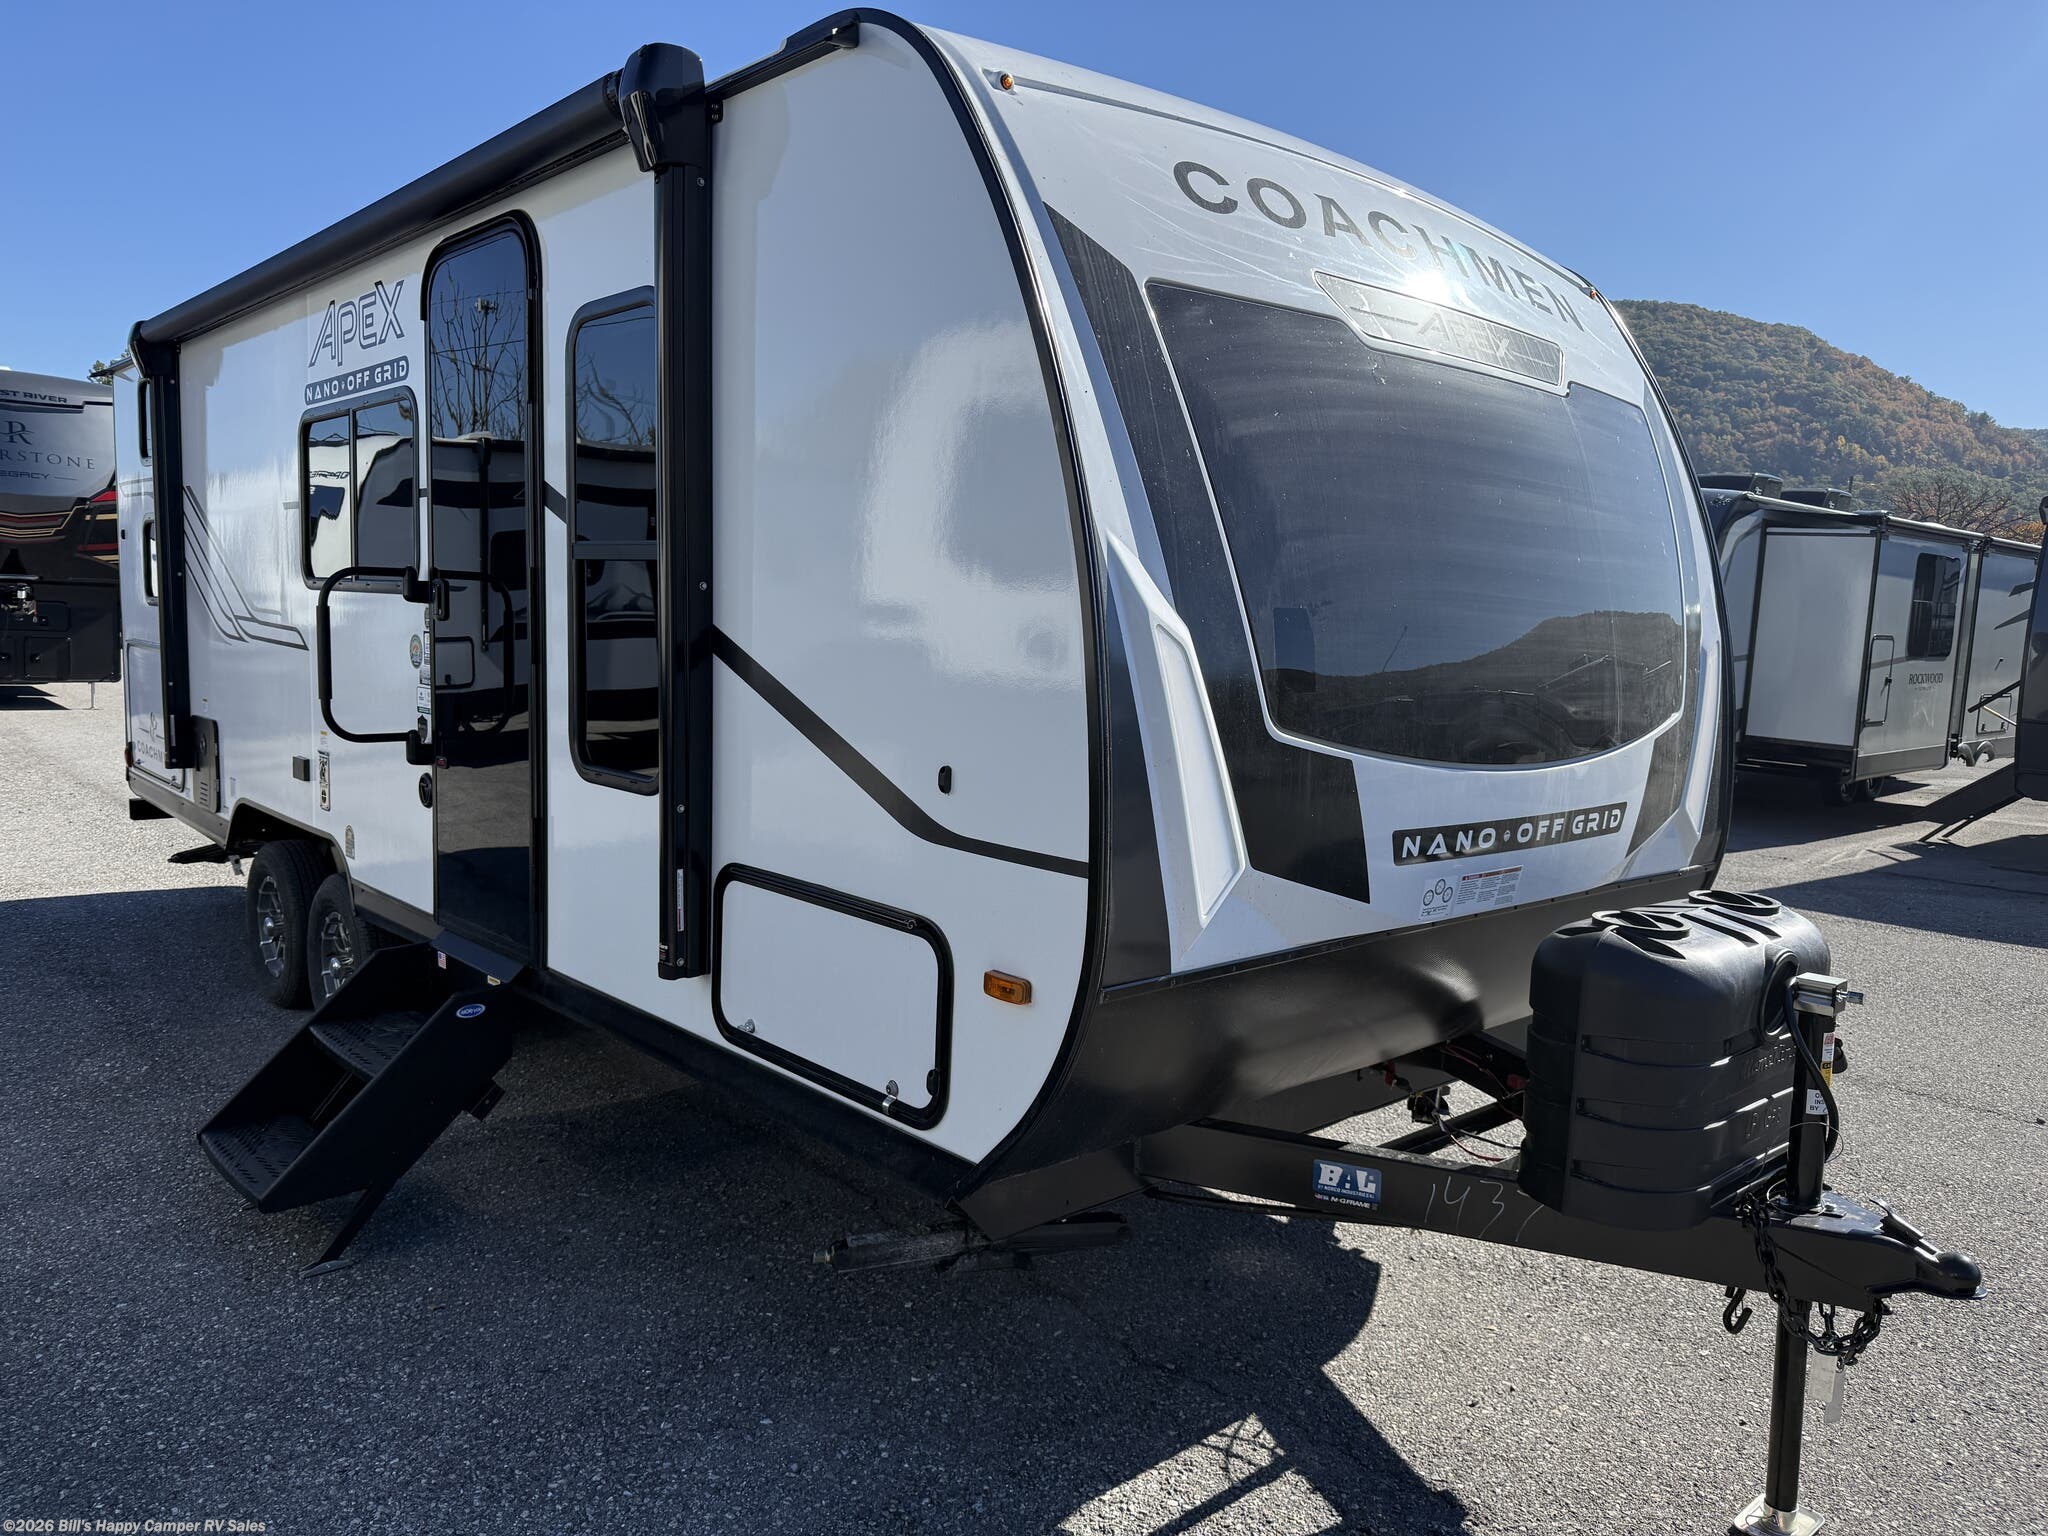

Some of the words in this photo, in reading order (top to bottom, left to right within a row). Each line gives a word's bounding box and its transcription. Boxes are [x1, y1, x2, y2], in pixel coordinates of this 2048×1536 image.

[1173, 160, 1585, 332] COACHMEN
[308, 280, 405, 368] APEX
[0, 389, 19, 397] ST
[22, 391, 67, 403] RIVER
[306, 380, 339, 402] NANO
[347, 370, 370, 391] OFF
[374, 360, 407, 383] GRID
[0, 448, 95, 469] RSTONE
[0, 469, 50, 479] EGACY
[1401, 827, 1496, 858] NANO
[1516, 818, 1565, 844] OFF
[1571, 808, 1621, 835] GRID
